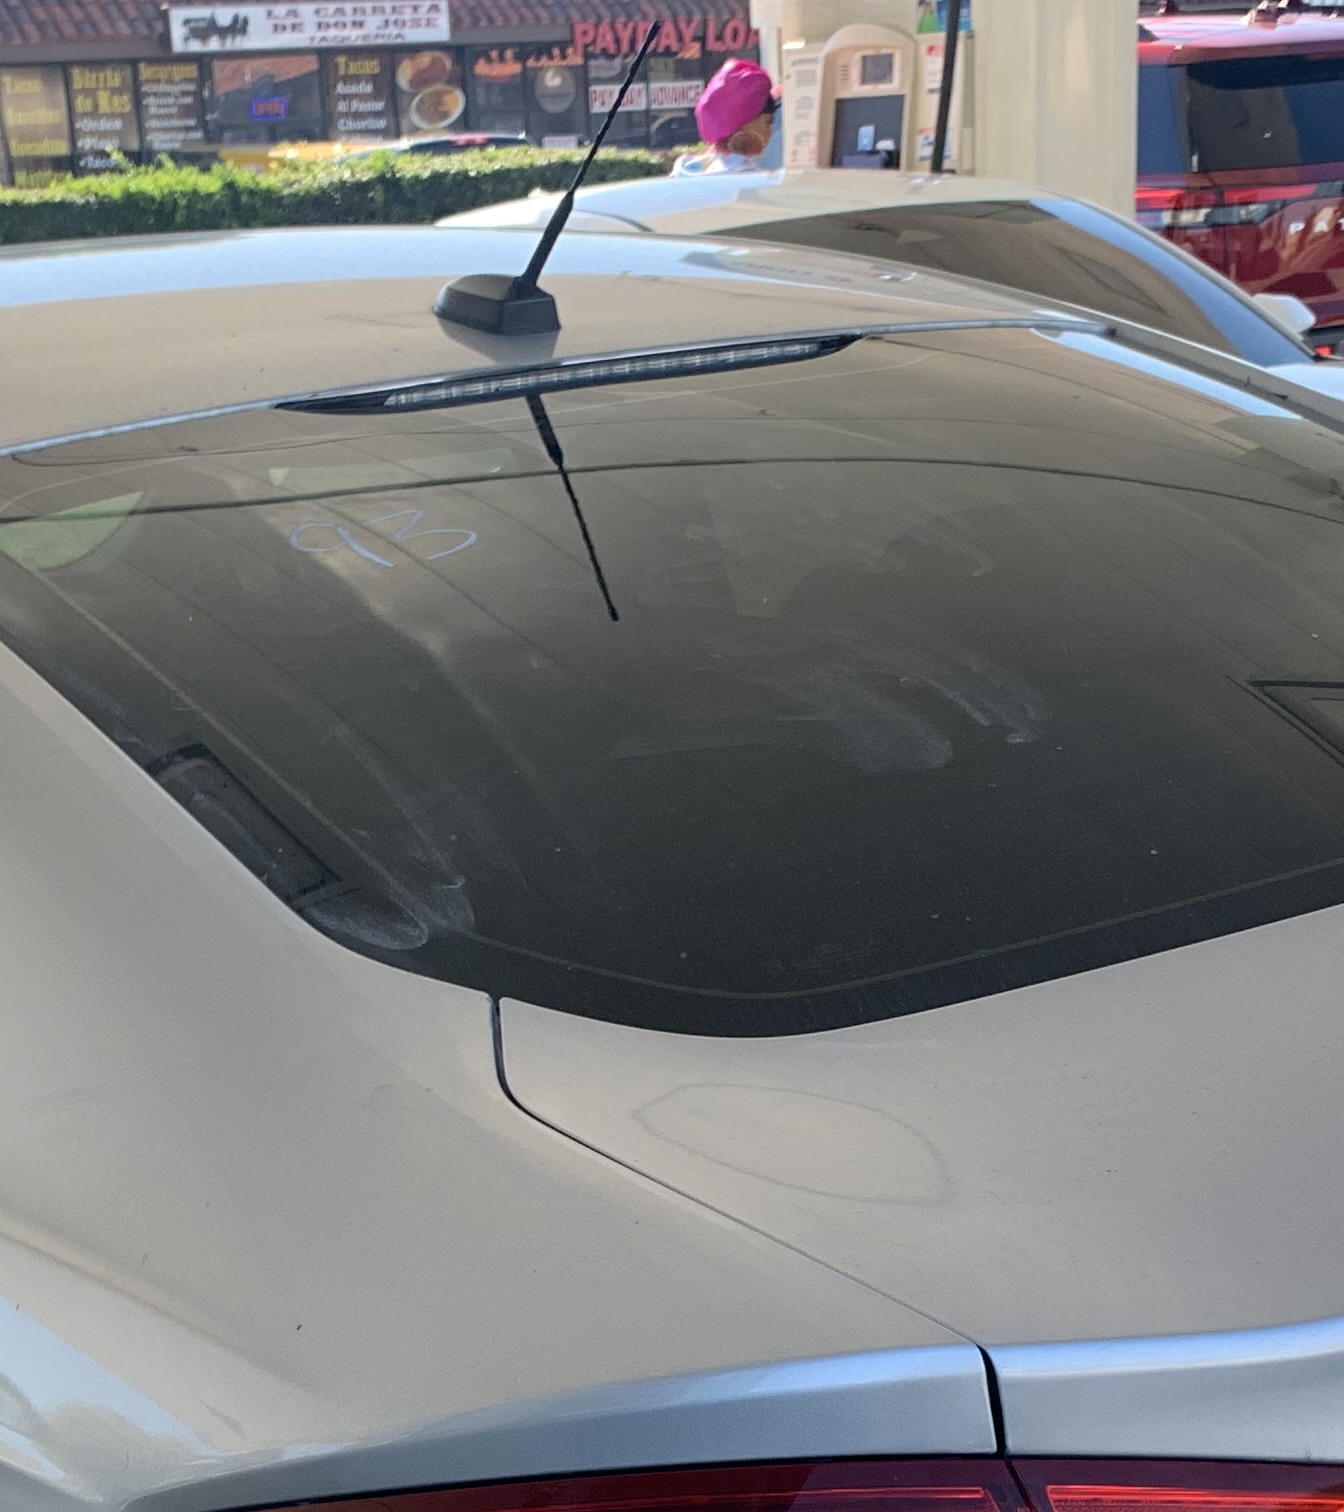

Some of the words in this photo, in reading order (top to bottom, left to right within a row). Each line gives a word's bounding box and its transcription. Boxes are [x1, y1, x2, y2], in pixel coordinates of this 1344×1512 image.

[265, 9, 299, 20] LA
[314, 3, 442, 18] CARRETA
[272, 22, 305, 34] DE
[317, 19, 365, 32] DON
[376, 17, 439, 31] JOSE
[308, 33, 406, 45] TAQUERIA
[573, 20, 698, 54] PAYDAY
